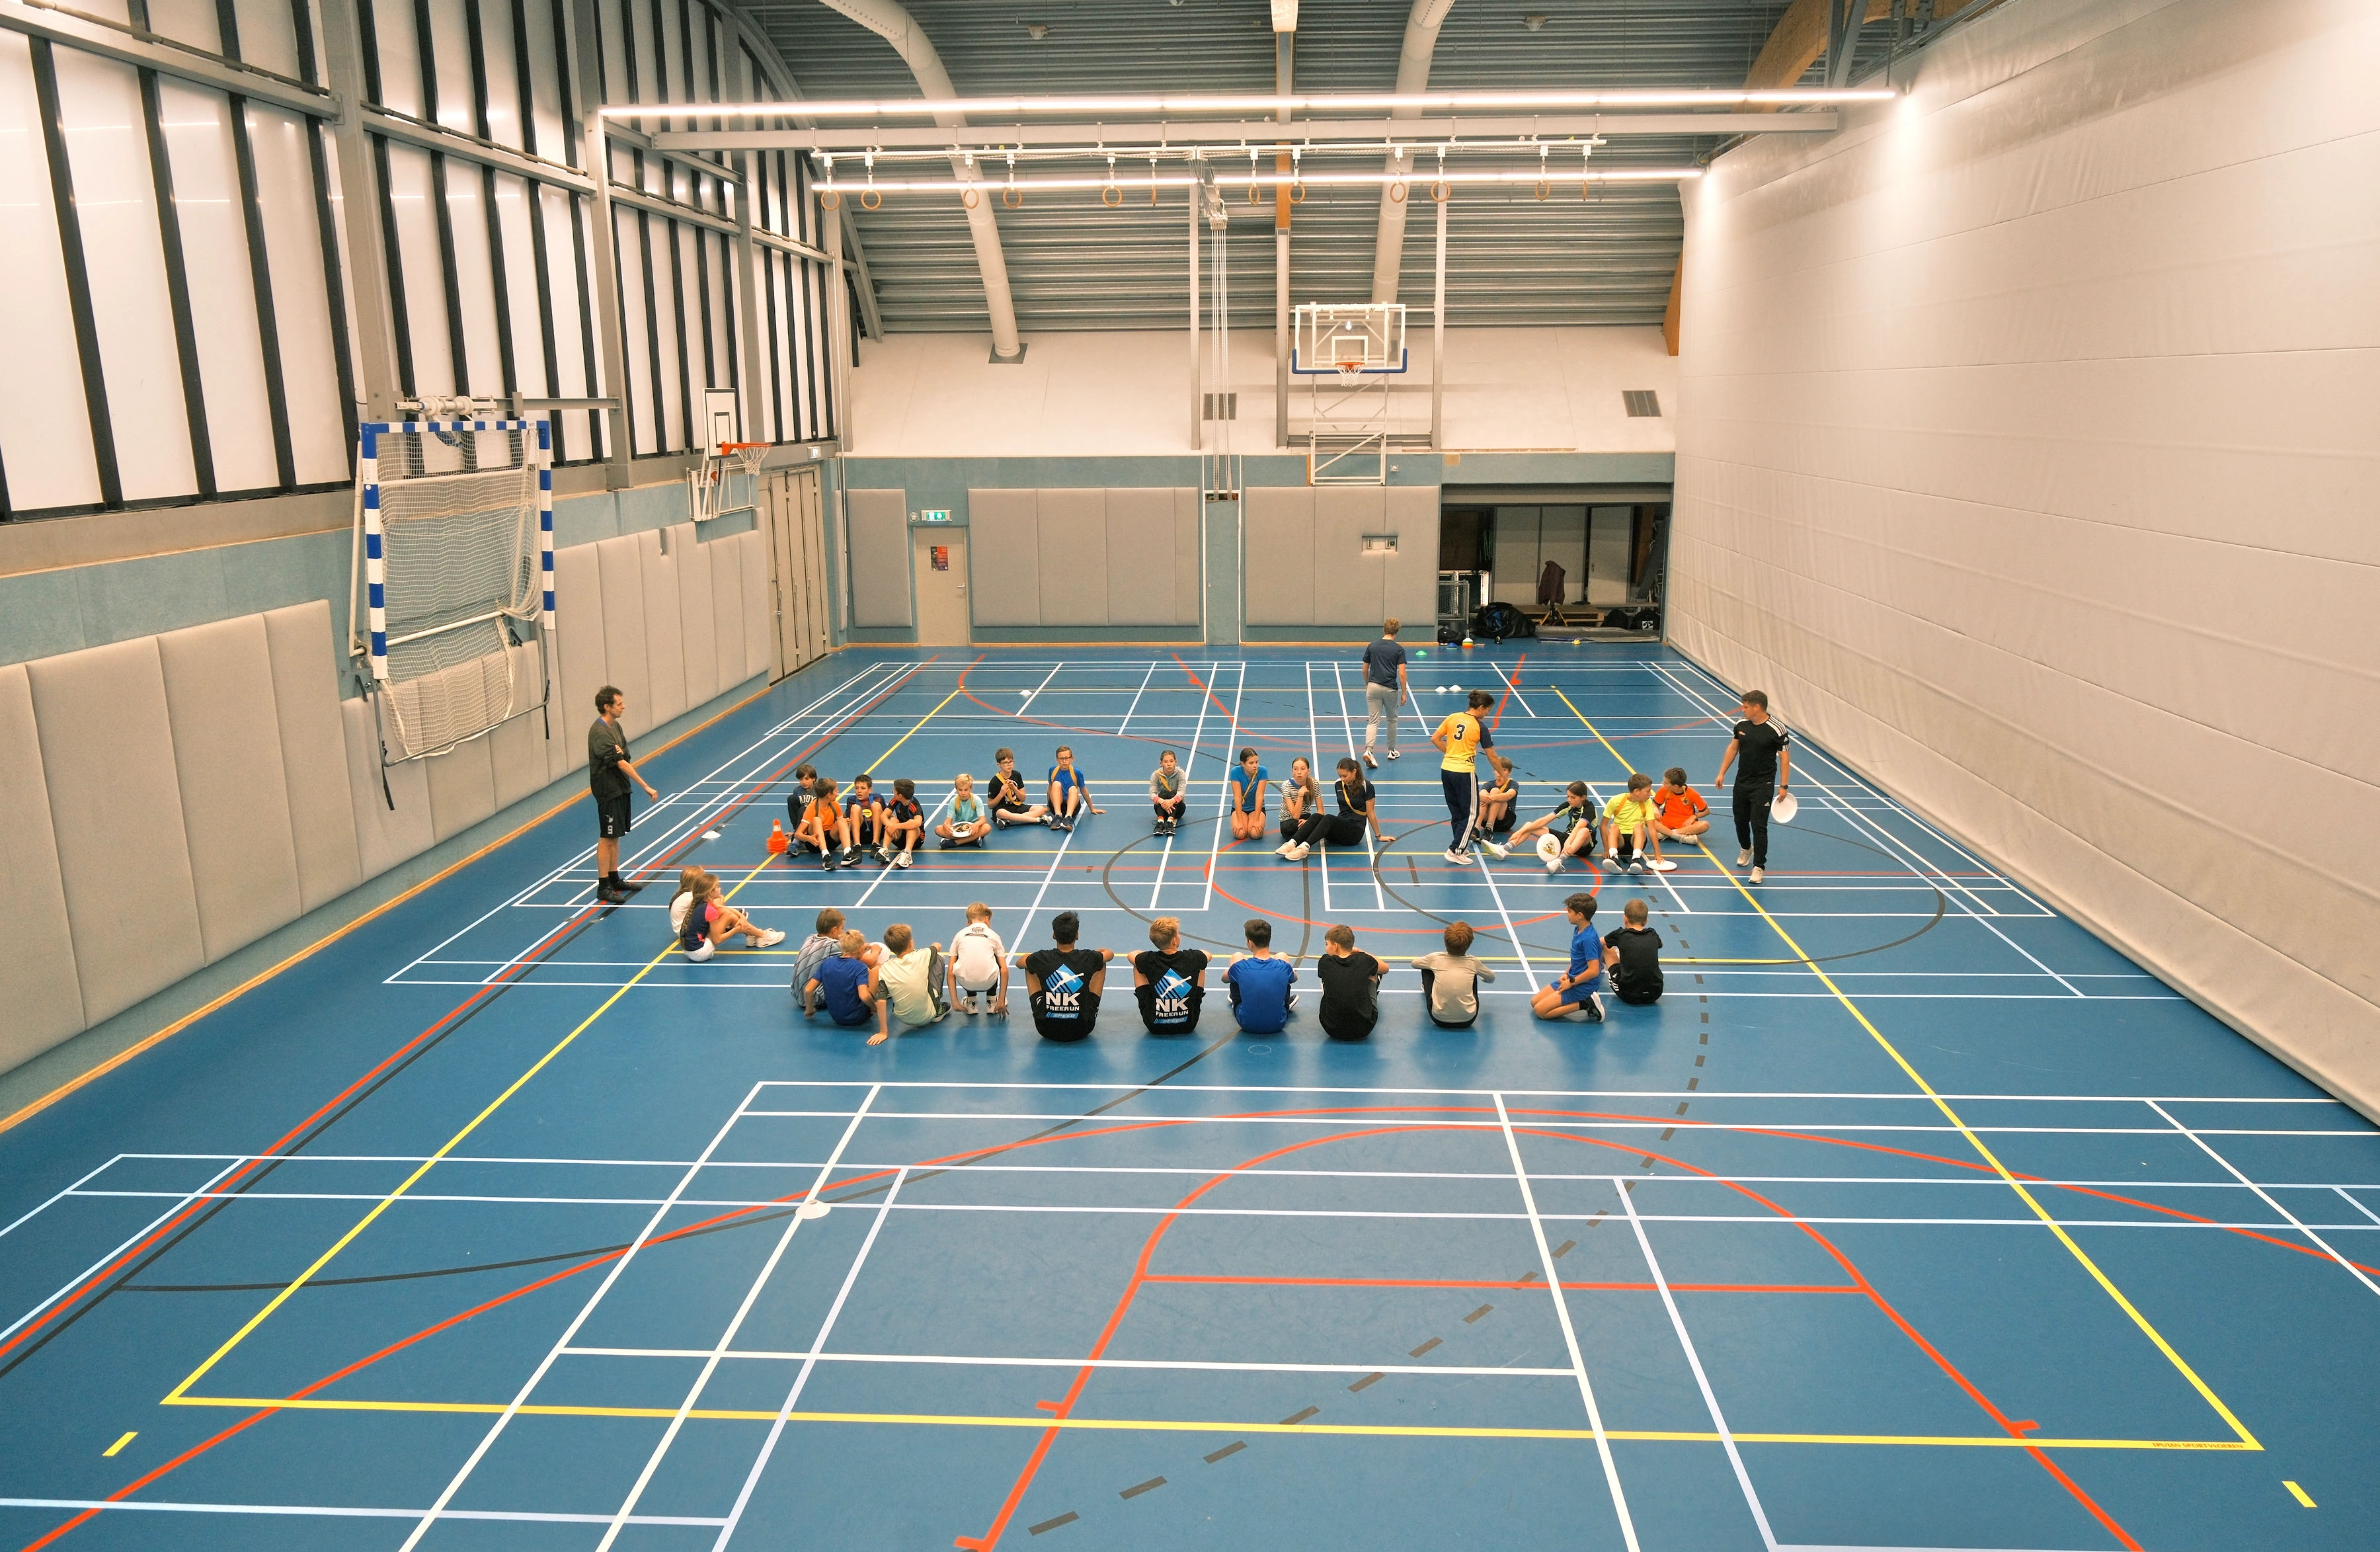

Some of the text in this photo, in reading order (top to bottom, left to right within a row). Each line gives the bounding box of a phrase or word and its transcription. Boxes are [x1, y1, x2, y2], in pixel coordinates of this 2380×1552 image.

[1454, 723, 1466, 741] 3
[1046, 991, 1080, 1006] NK
[1156, 997, 1189, 1012] NK
